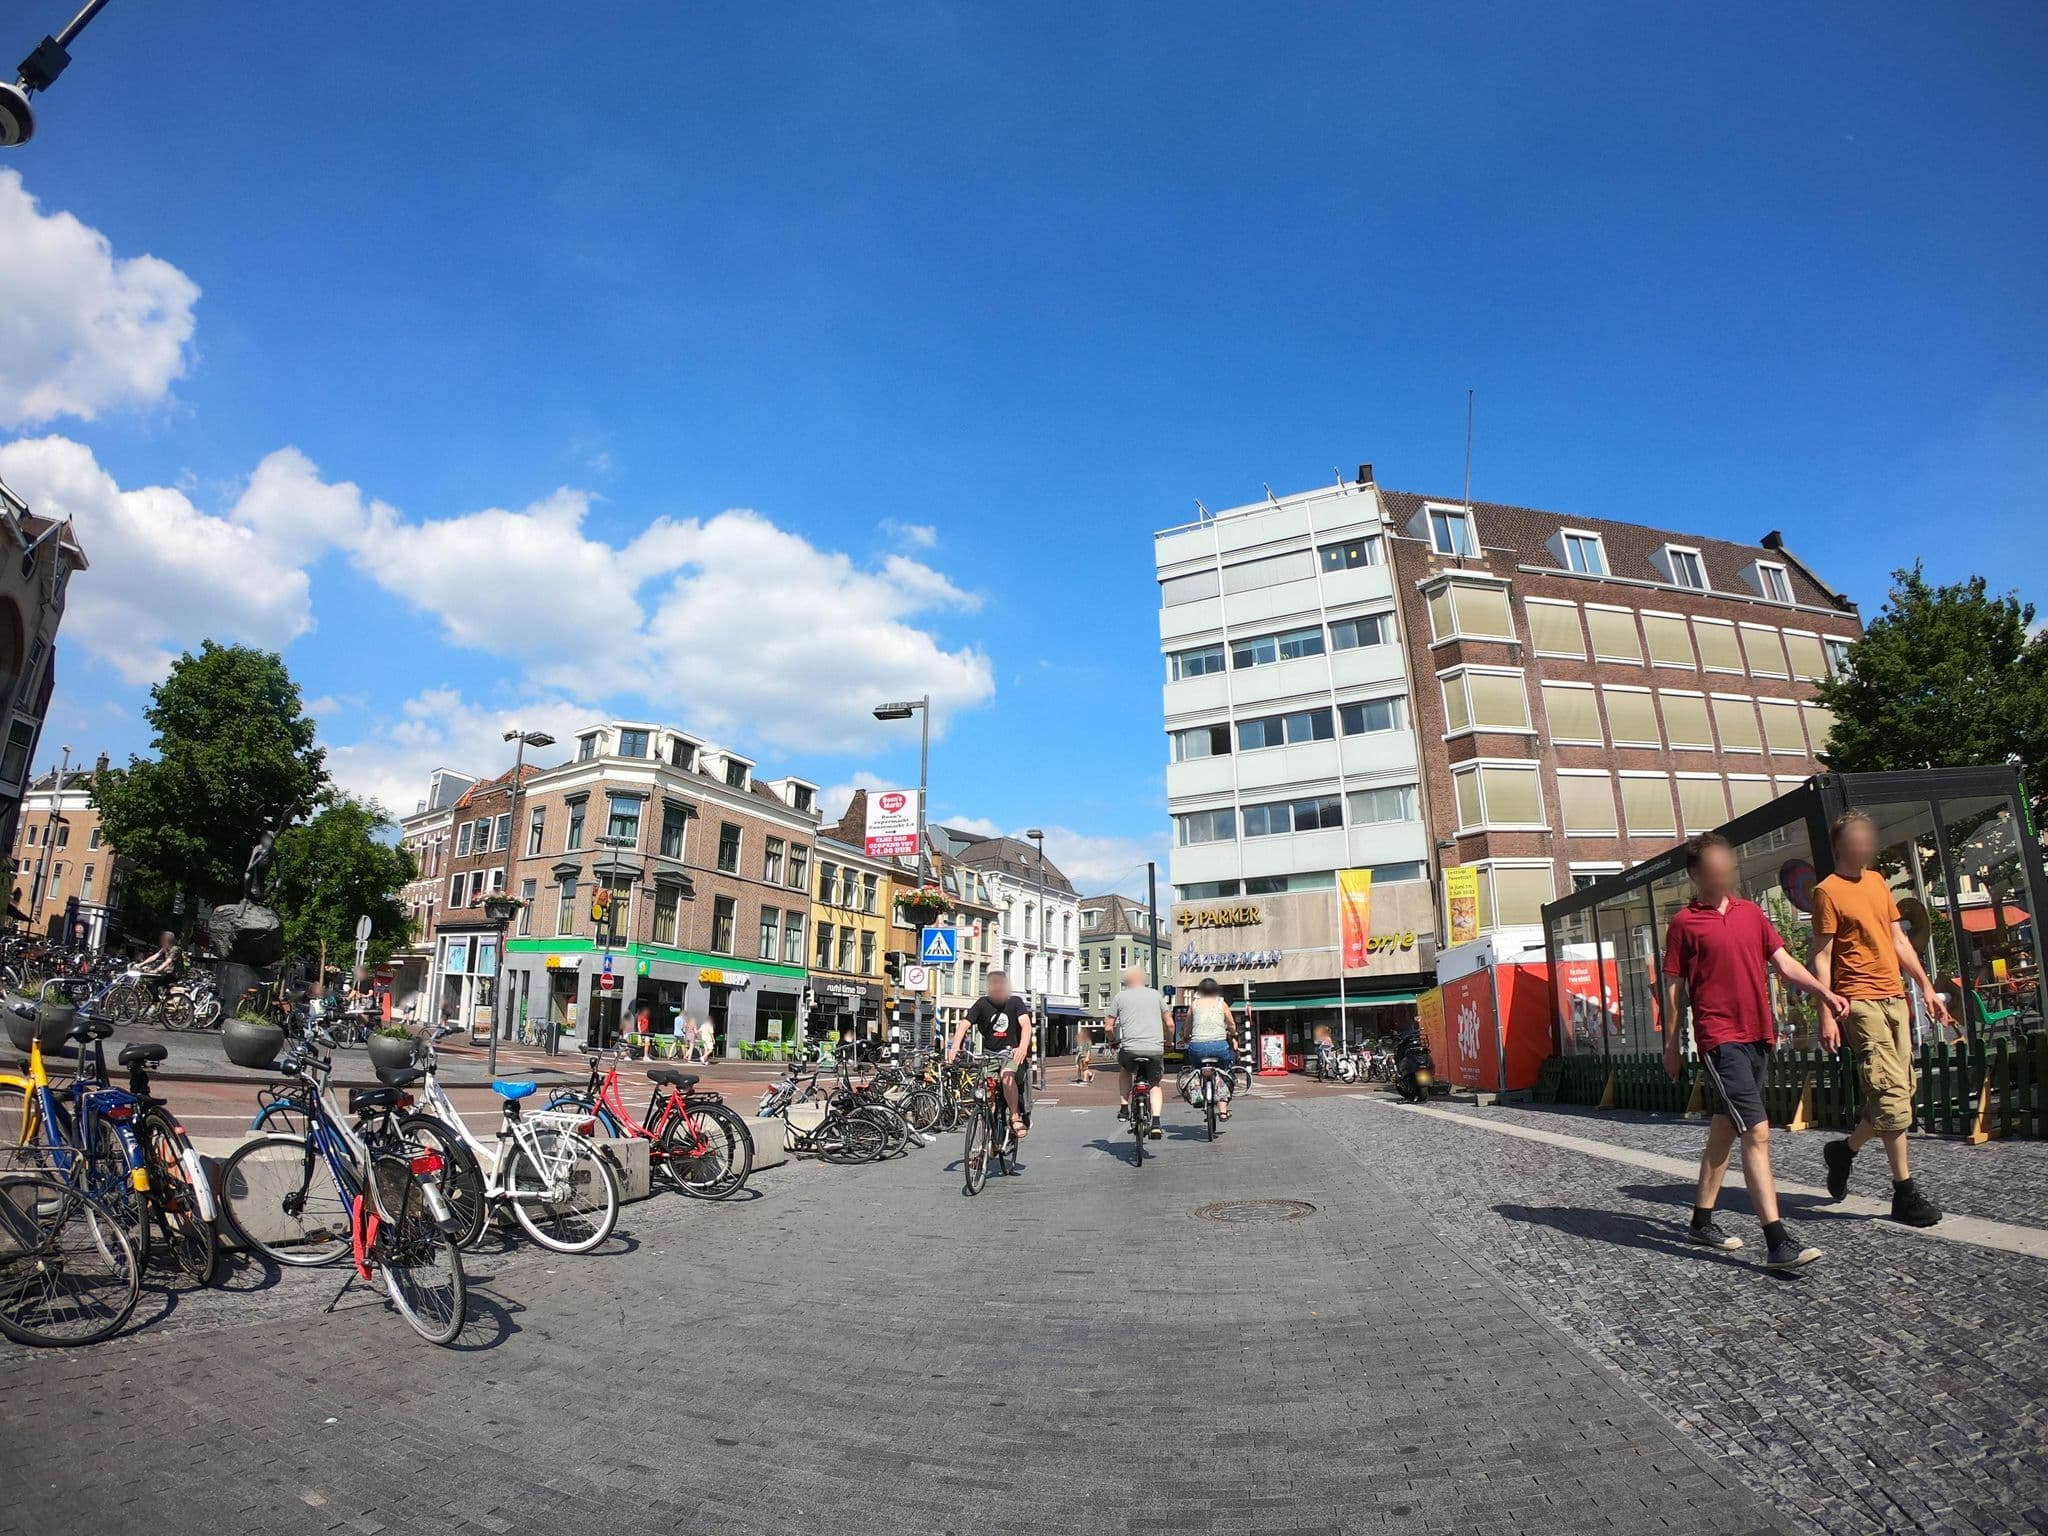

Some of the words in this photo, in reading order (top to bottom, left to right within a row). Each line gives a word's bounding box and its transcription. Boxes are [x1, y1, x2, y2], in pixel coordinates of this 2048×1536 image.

[871, 847, 894, 855] 24.00
[1199, 906, 1260, 926] PARKER
[1180, 941, 1281, 969] WATERMAN
